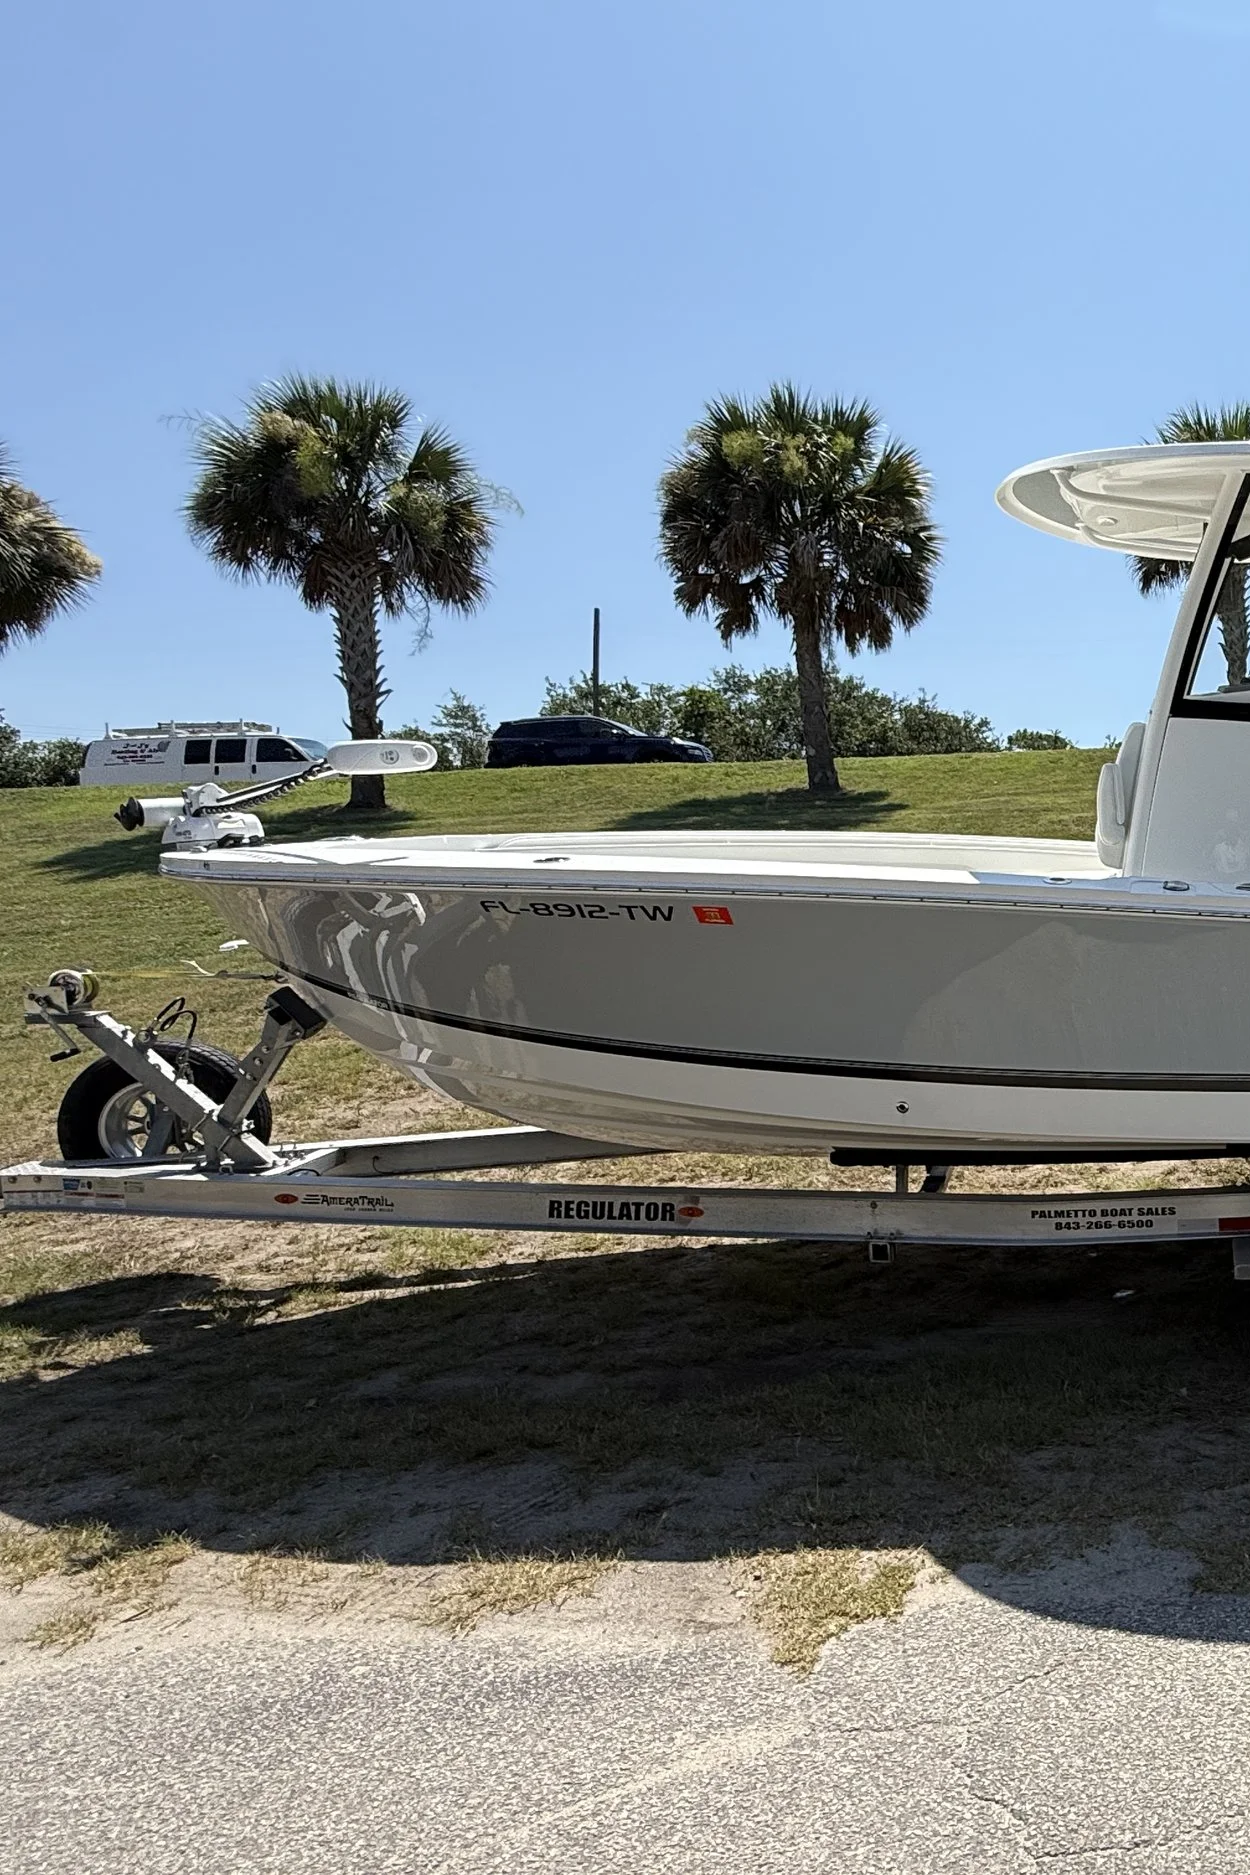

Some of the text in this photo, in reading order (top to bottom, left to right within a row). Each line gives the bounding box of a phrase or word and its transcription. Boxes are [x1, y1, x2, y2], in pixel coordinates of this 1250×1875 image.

[480, 900, 674, 922] FL-8912-TW
[548, 1199, 676, 1222] REGULATOR
[1031, 1206, 1177, 1219] PALMETTO BOAT SALES
[1054, 1219, 1154, 1231] 843-266-6500
